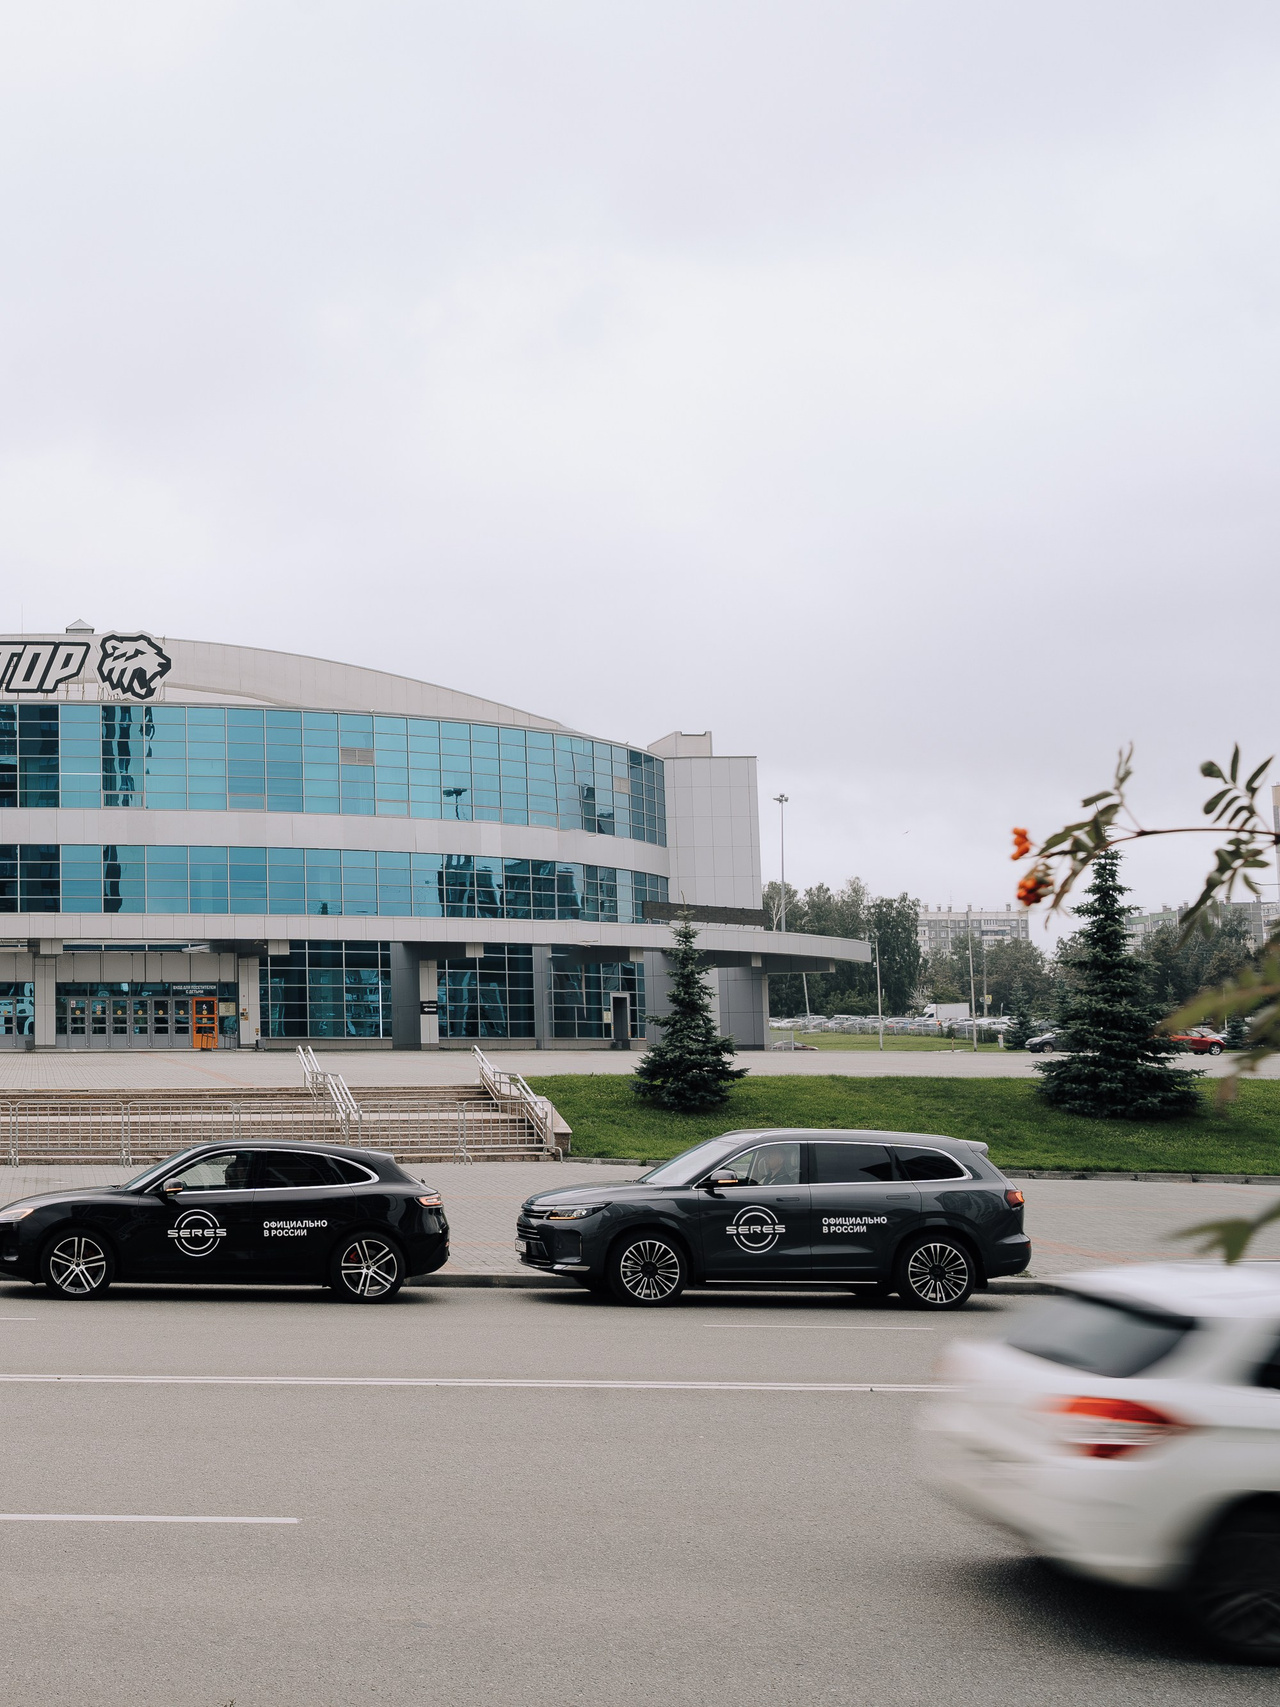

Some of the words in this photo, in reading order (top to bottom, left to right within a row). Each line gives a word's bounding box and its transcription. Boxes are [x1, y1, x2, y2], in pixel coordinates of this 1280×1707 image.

[263, 1219, 328, 1229] ОФИЦИАЛЬНО
[822, 1216, 887, 1226] ОФИЦИАЛЬНО
[167, 1228, 227, 1238] SERES
[263, 1229, 270, 1237] В
[271, 1229, 307, 1237] РОССИИ
[726, 1224, 786, 1235] SERES
[830, 1225, 867, 1233] РОССИИ
